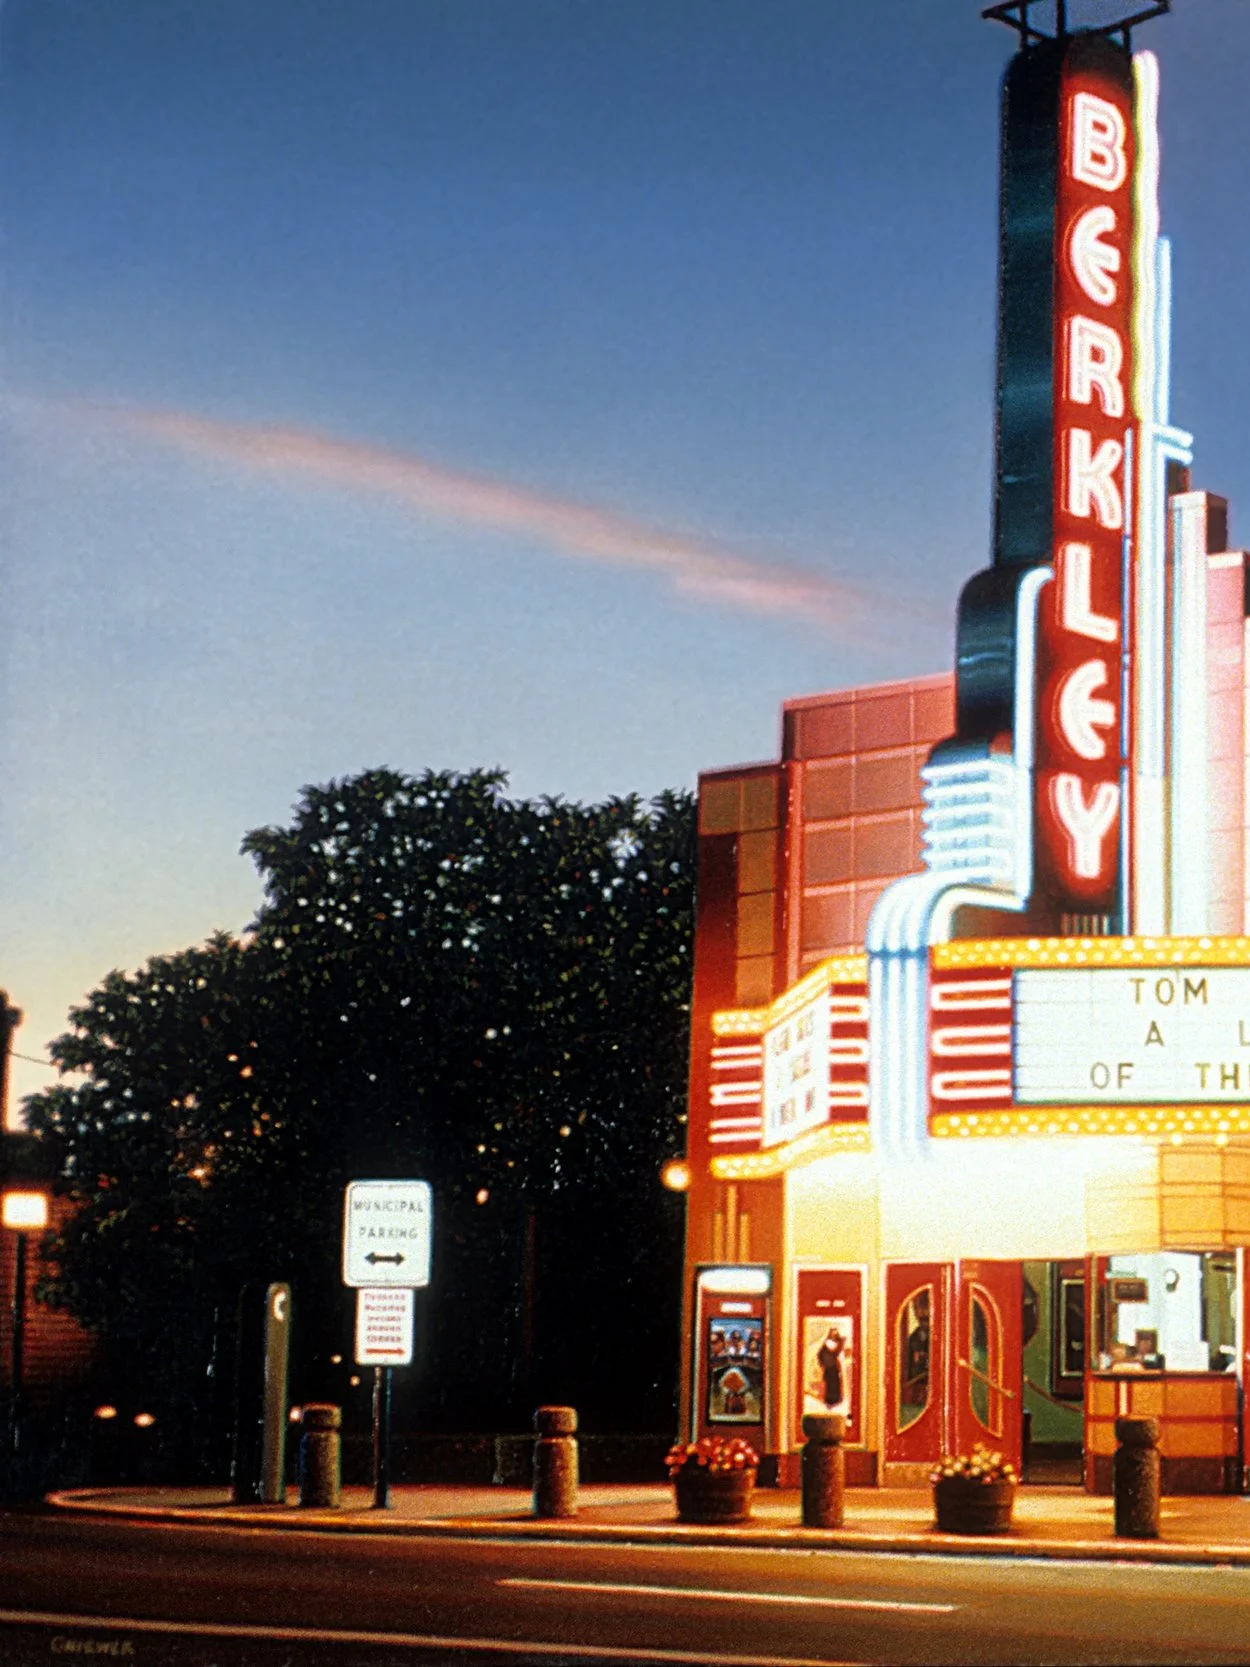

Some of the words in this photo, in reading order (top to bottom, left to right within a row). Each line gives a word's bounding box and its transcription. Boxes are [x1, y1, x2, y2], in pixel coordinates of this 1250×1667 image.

[1055, 92, 1128, 880] BERKLEY
[1129, 977, 1208, 1005] TOM
[1144, 1020, 1165, 1047] A
[1090, 1062, 1134, 1090] OF
[354, 1200, 423, 1213] MUNICIPAL
[359, 1226, 418, 1240] PARKING
